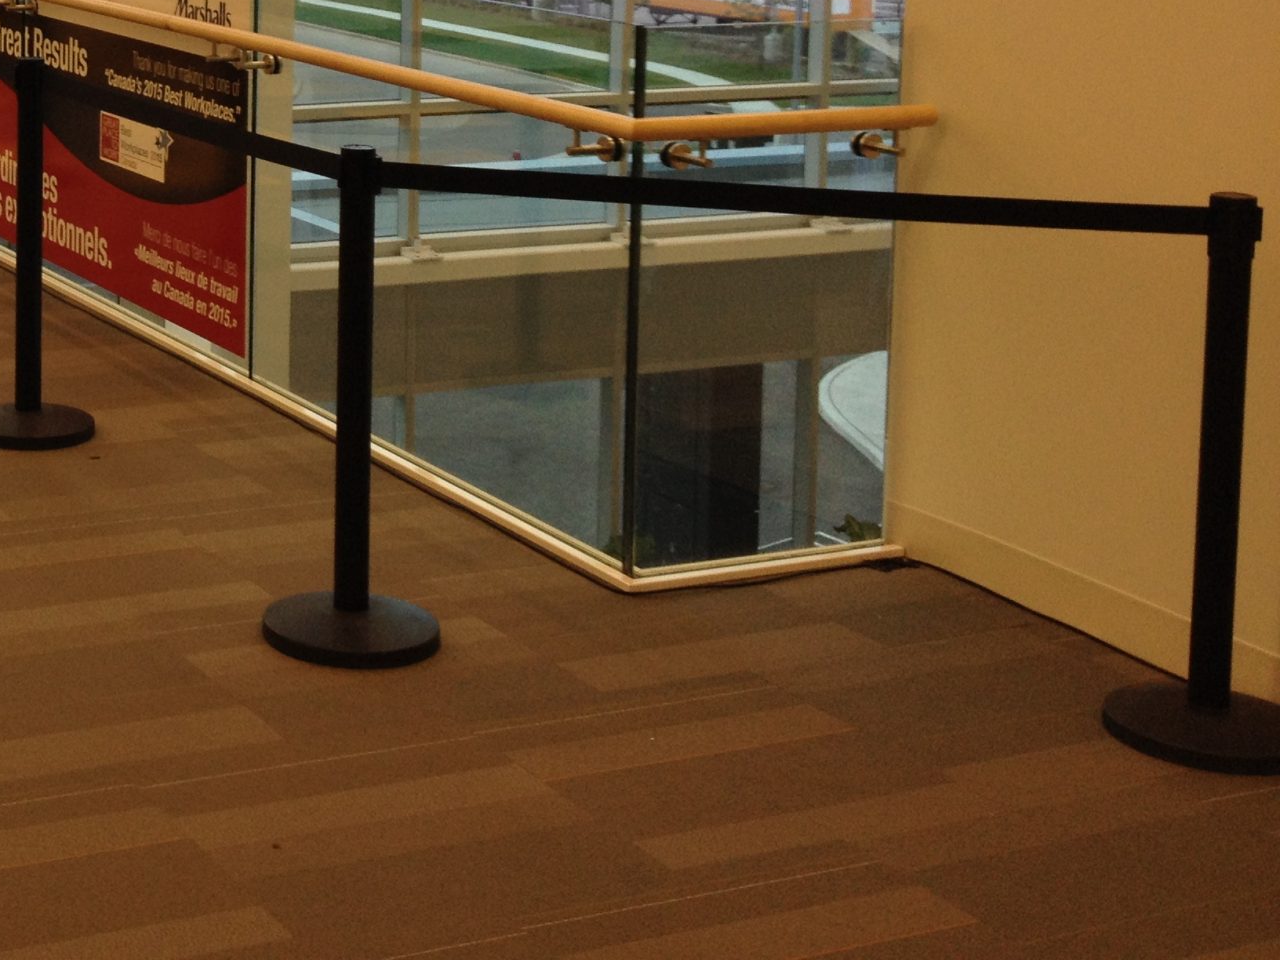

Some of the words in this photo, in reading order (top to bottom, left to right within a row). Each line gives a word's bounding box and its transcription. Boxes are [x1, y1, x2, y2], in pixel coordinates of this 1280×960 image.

[33, 28, 89, 78] Results
[143, 79, 163, 101] 2015
[164, 85, 183, 107] Best
[151, 278, 163, 294] au
[163, 281, 195, 310] Canada
[196, 299, 208, 317] en
[175, 259, 196, 285] lieux
[197, 271, 208, 290] de
[210, 277, 239, 304] travail
